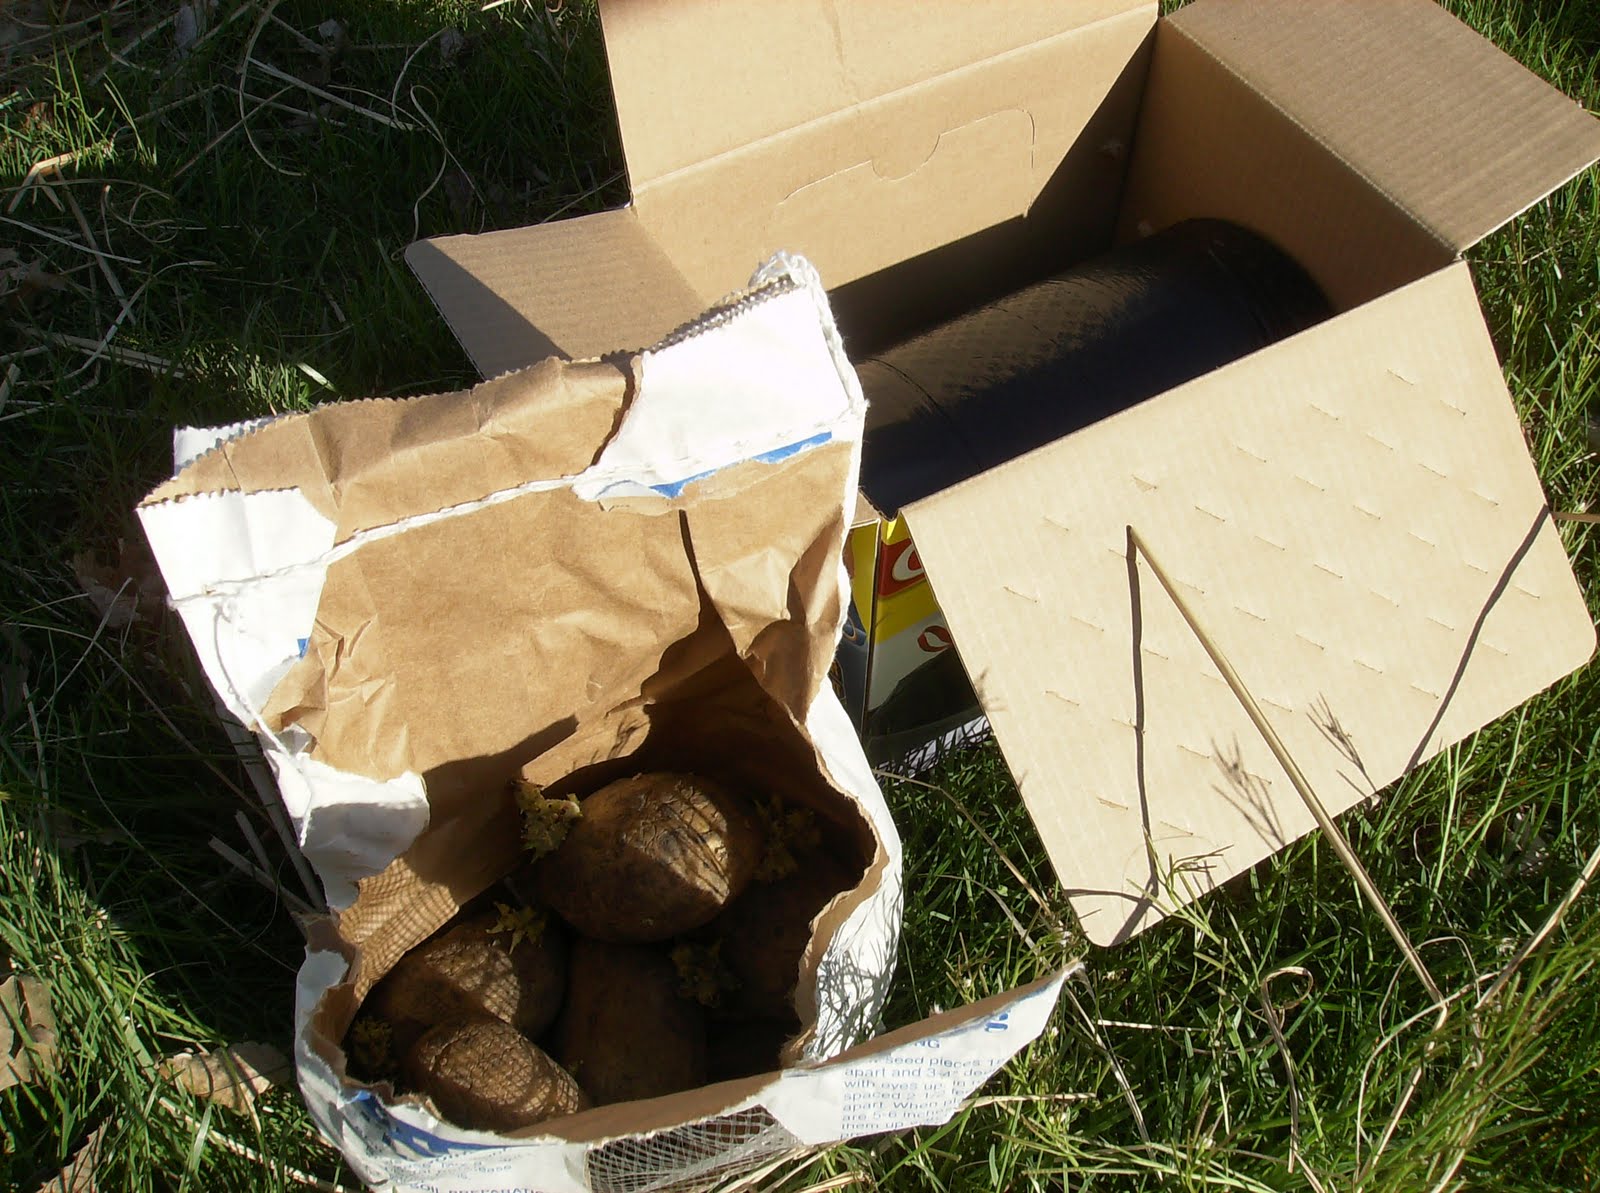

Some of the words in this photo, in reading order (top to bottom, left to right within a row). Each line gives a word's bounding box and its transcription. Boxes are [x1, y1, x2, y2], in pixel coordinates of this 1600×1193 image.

[844, 1067, 886, 1078] apart
[891, 1066, 922, 1077] and
[844, 1079, 876, 1089] with
[880, 1082, 918, 1091] eyes
[844, 1092, 901, 1102] spaced
[893, 1101, 937, 1110] When
[841, 1122, 880, 1131] them
